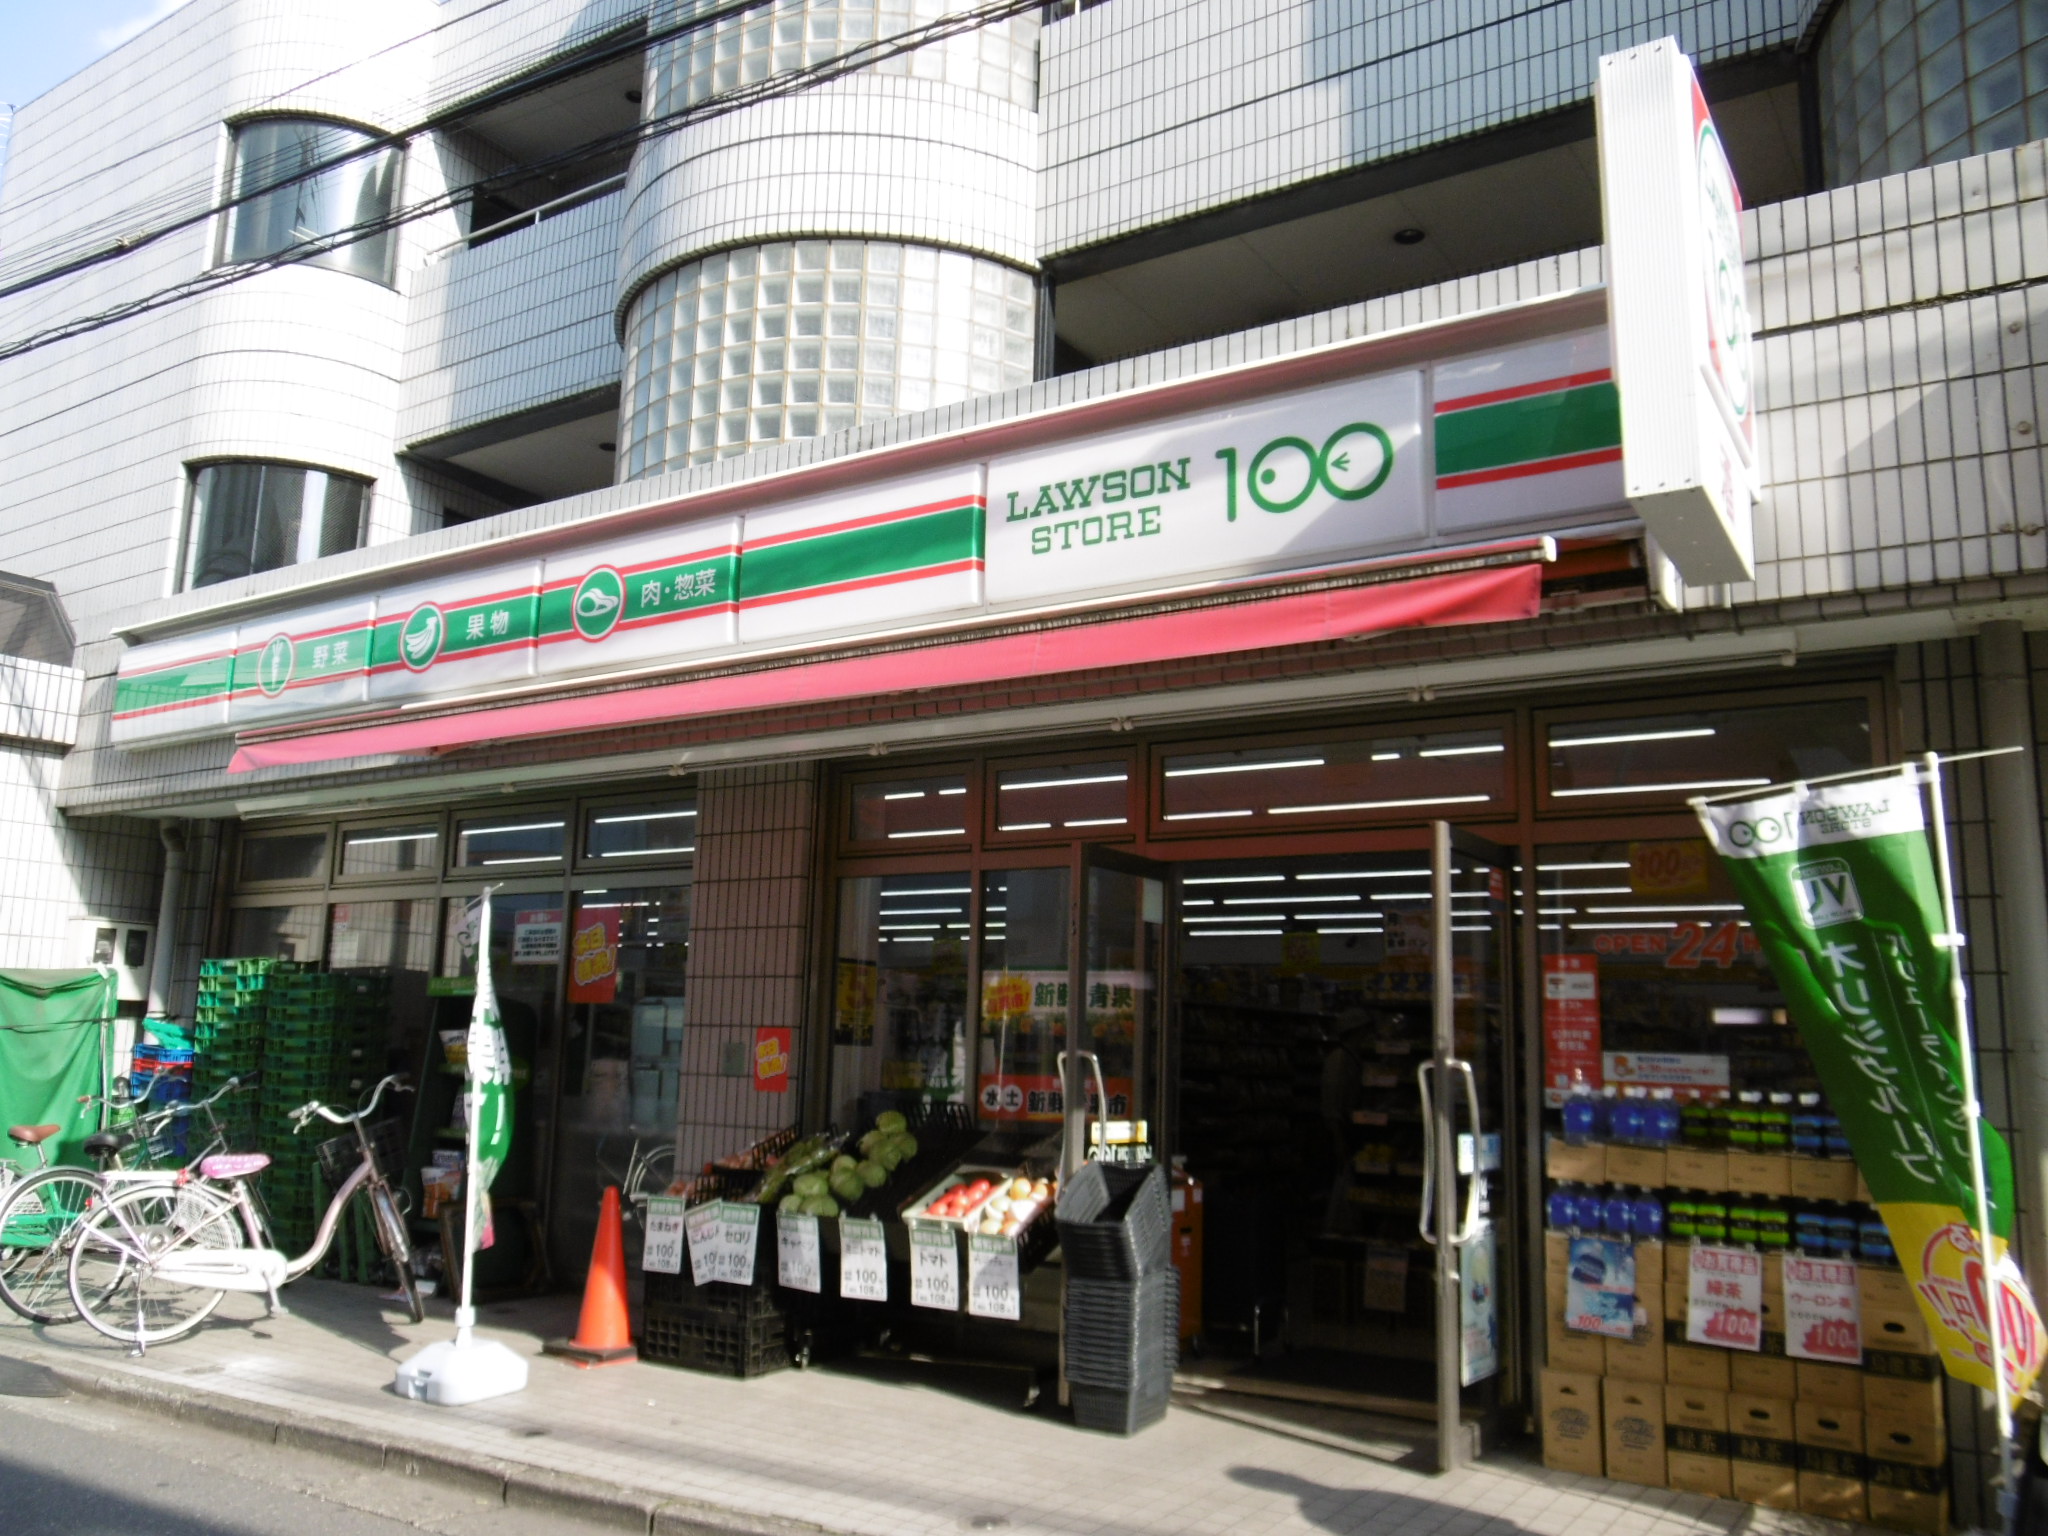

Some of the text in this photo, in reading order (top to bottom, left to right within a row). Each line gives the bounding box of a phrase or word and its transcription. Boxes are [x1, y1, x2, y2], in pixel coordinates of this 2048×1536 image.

[1006, 457, 1191, 522] LAWSON
[1215, 422, 1394, 522] 100
[1031, 505, 1161, 554] STORE
[465, 611, 509, 640] 果物
[312, 642, 349, 670] 野菜
[1595, 934, 1667, 955] OPEN
[1665, 920, 1738, 969] 24
[725, 1229, 751, 1245] セロリ
[920, 1252, 948, 1268] トマト
